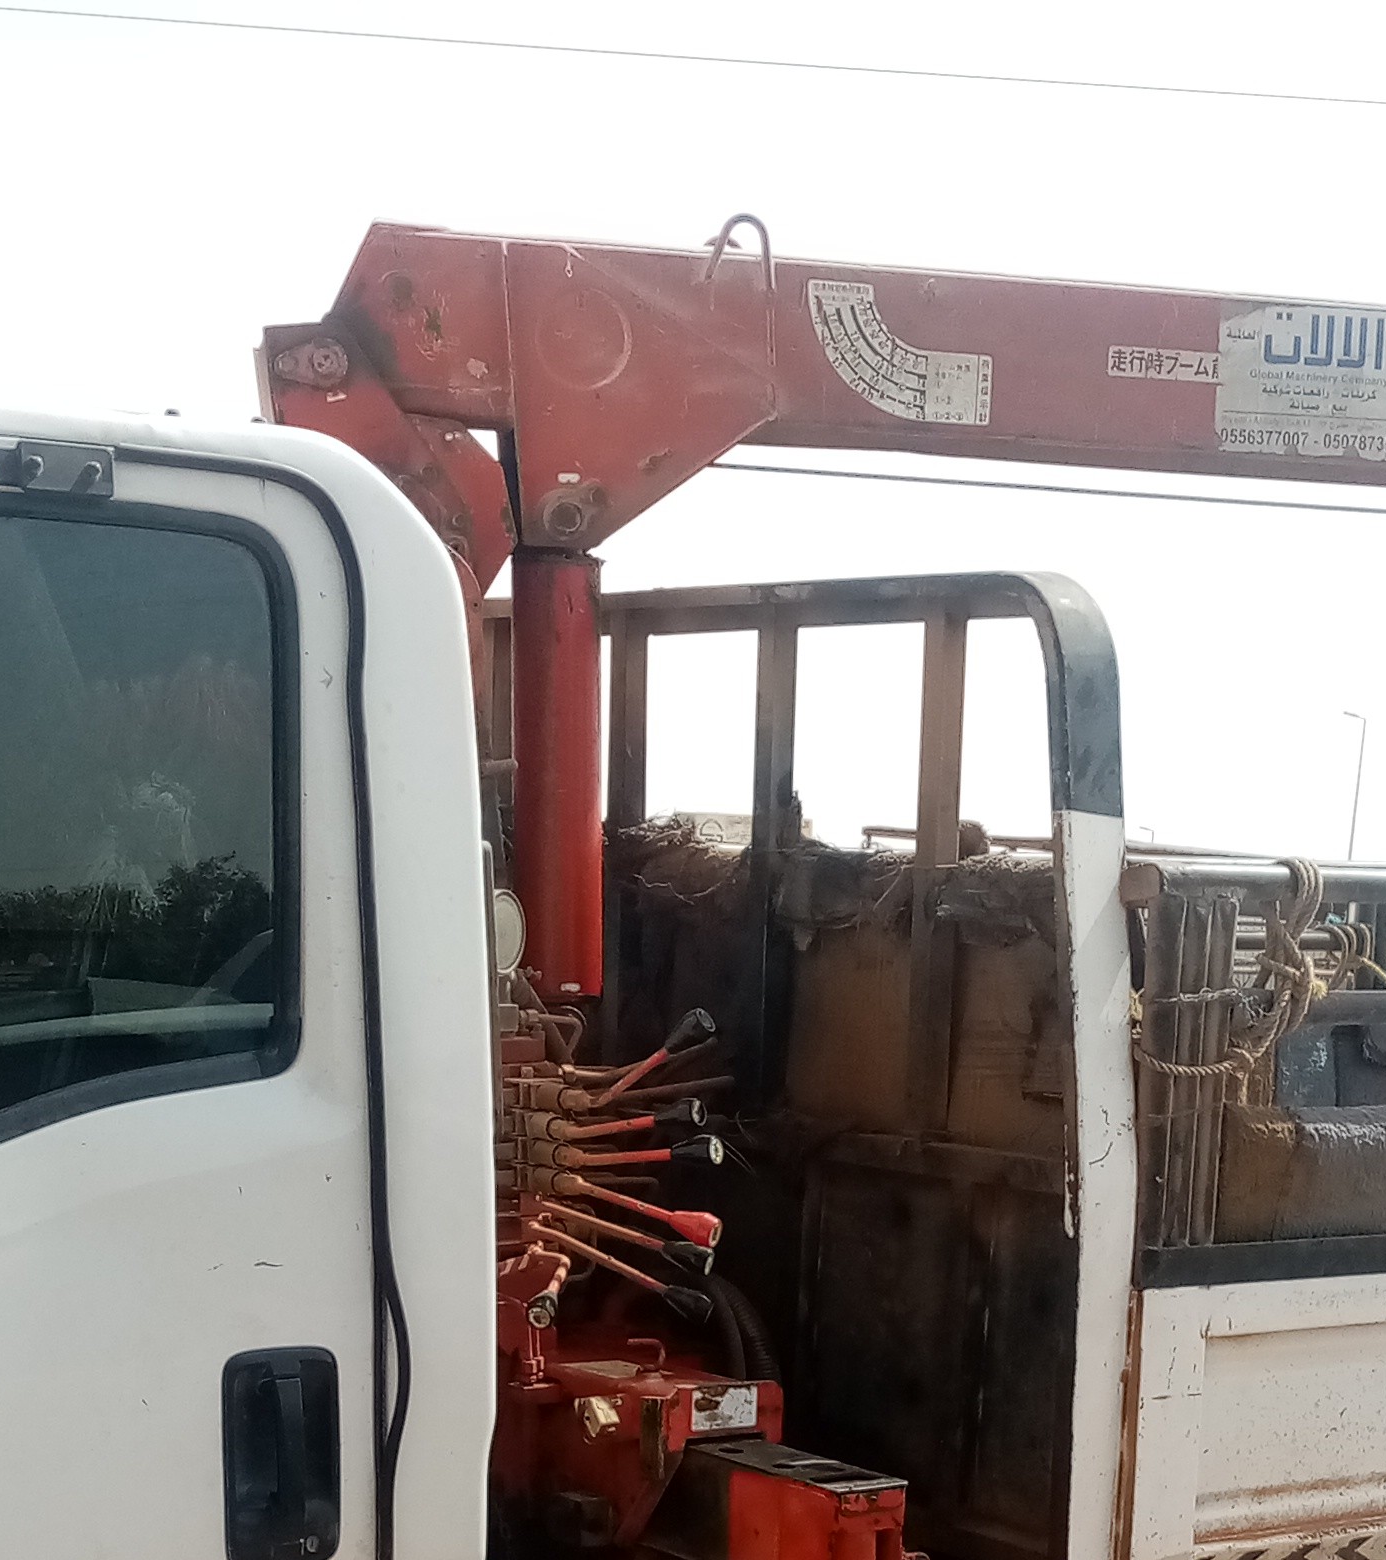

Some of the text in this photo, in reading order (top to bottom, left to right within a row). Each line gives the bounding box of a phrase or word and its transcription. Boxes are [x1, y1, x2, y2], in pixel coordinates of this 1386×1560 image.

[1249, 368, 1283, 379] Global
[1286, 370, 1338, 385] Machinery
[1220, 427, 1309, 447] 0556377007
